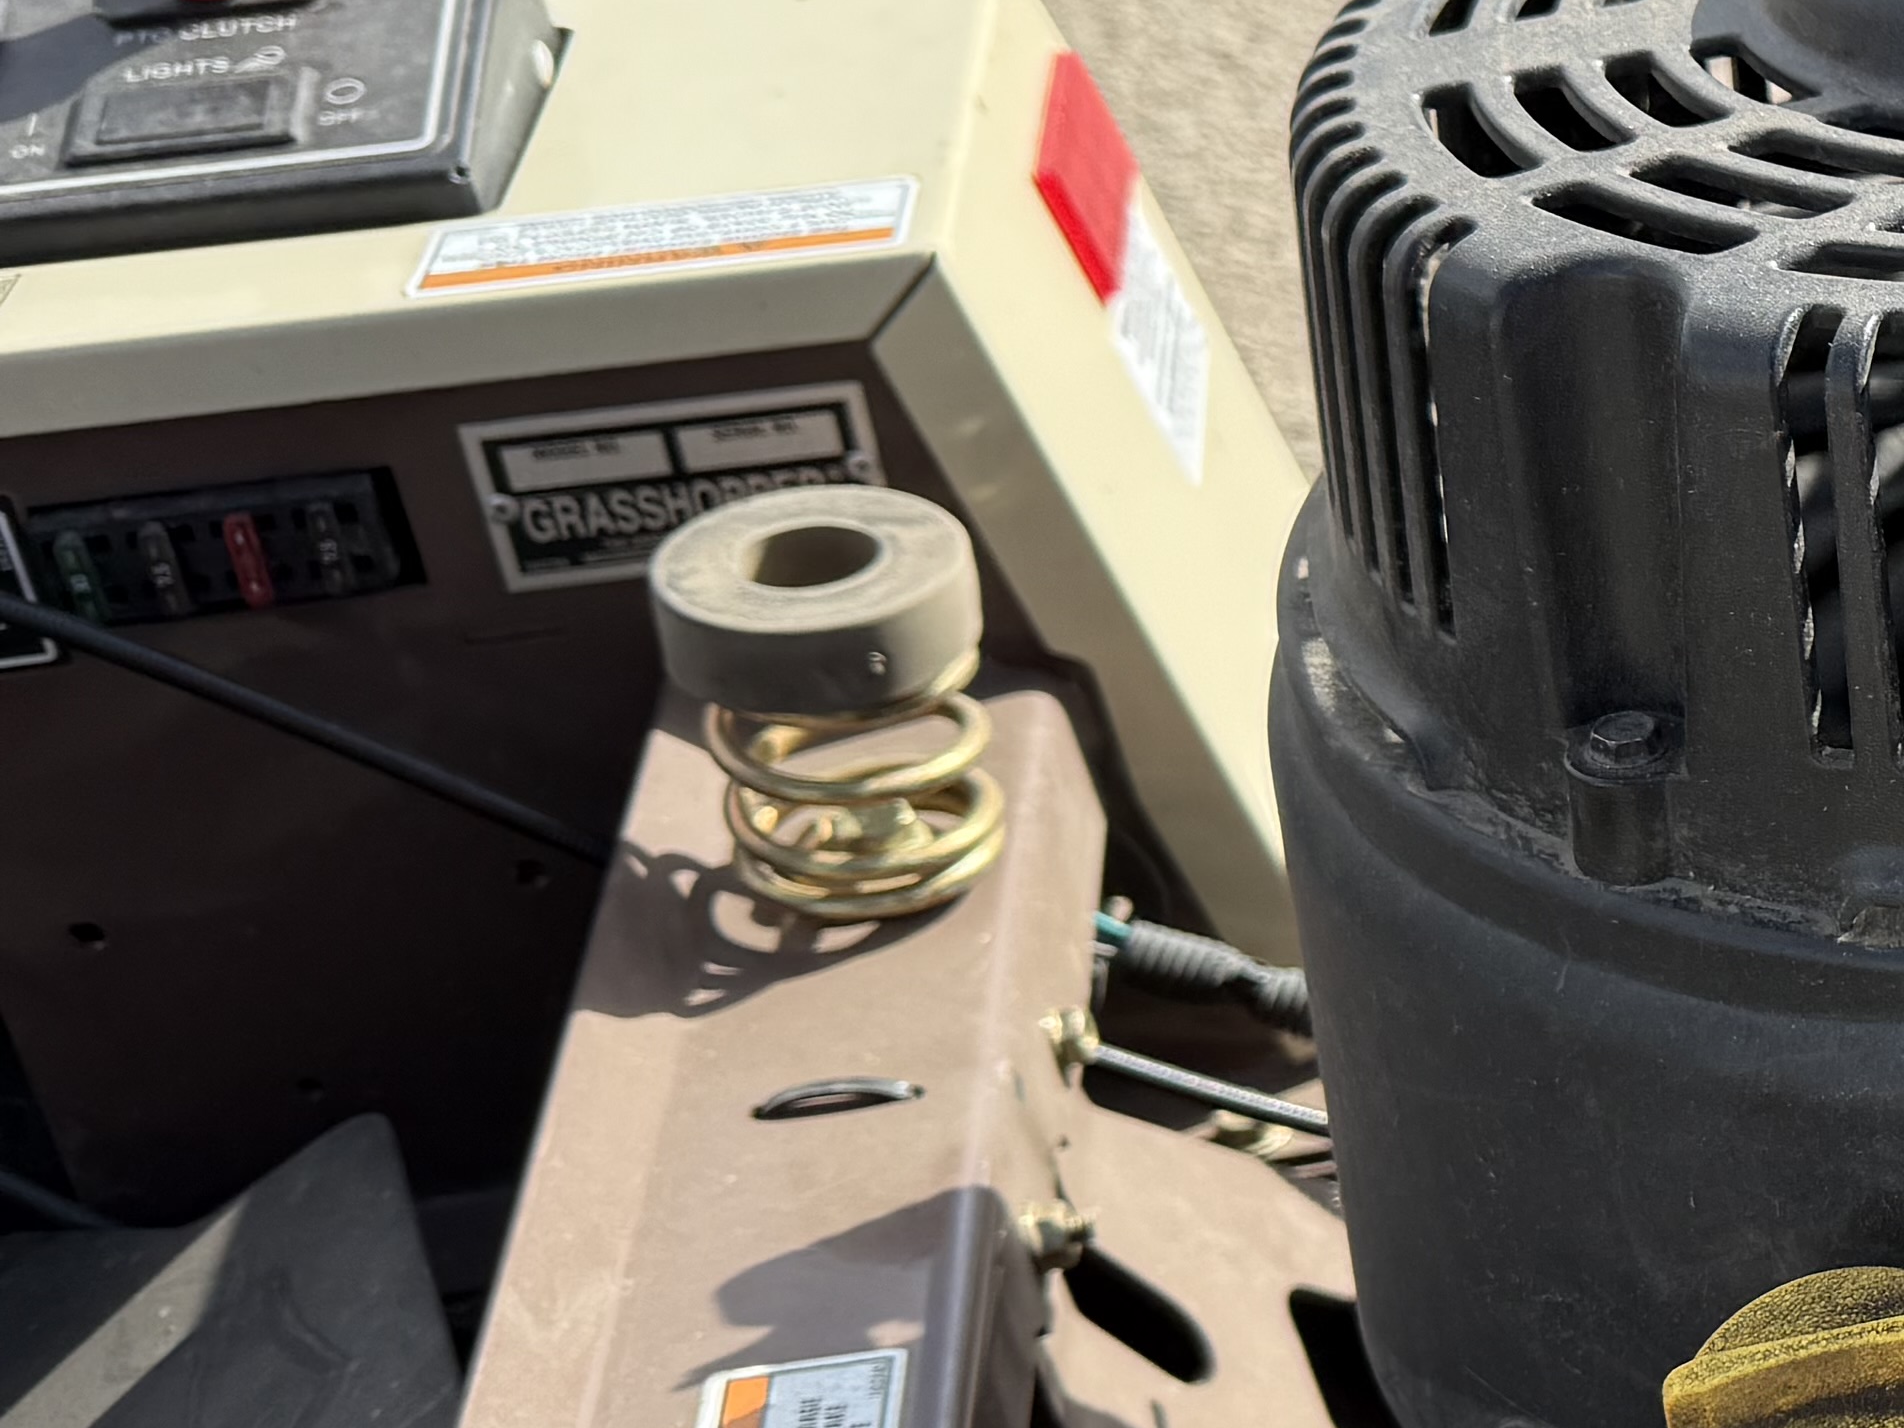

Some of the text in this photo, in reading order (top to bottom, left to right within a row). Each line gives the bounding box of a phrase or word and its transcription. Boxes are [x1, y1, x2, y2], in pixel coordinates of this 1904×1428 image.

[177, 14, 297, 42] CLUTCH
[124, 55, 231, 83] LIGHTS
[9, 143, 46, 160] ON
